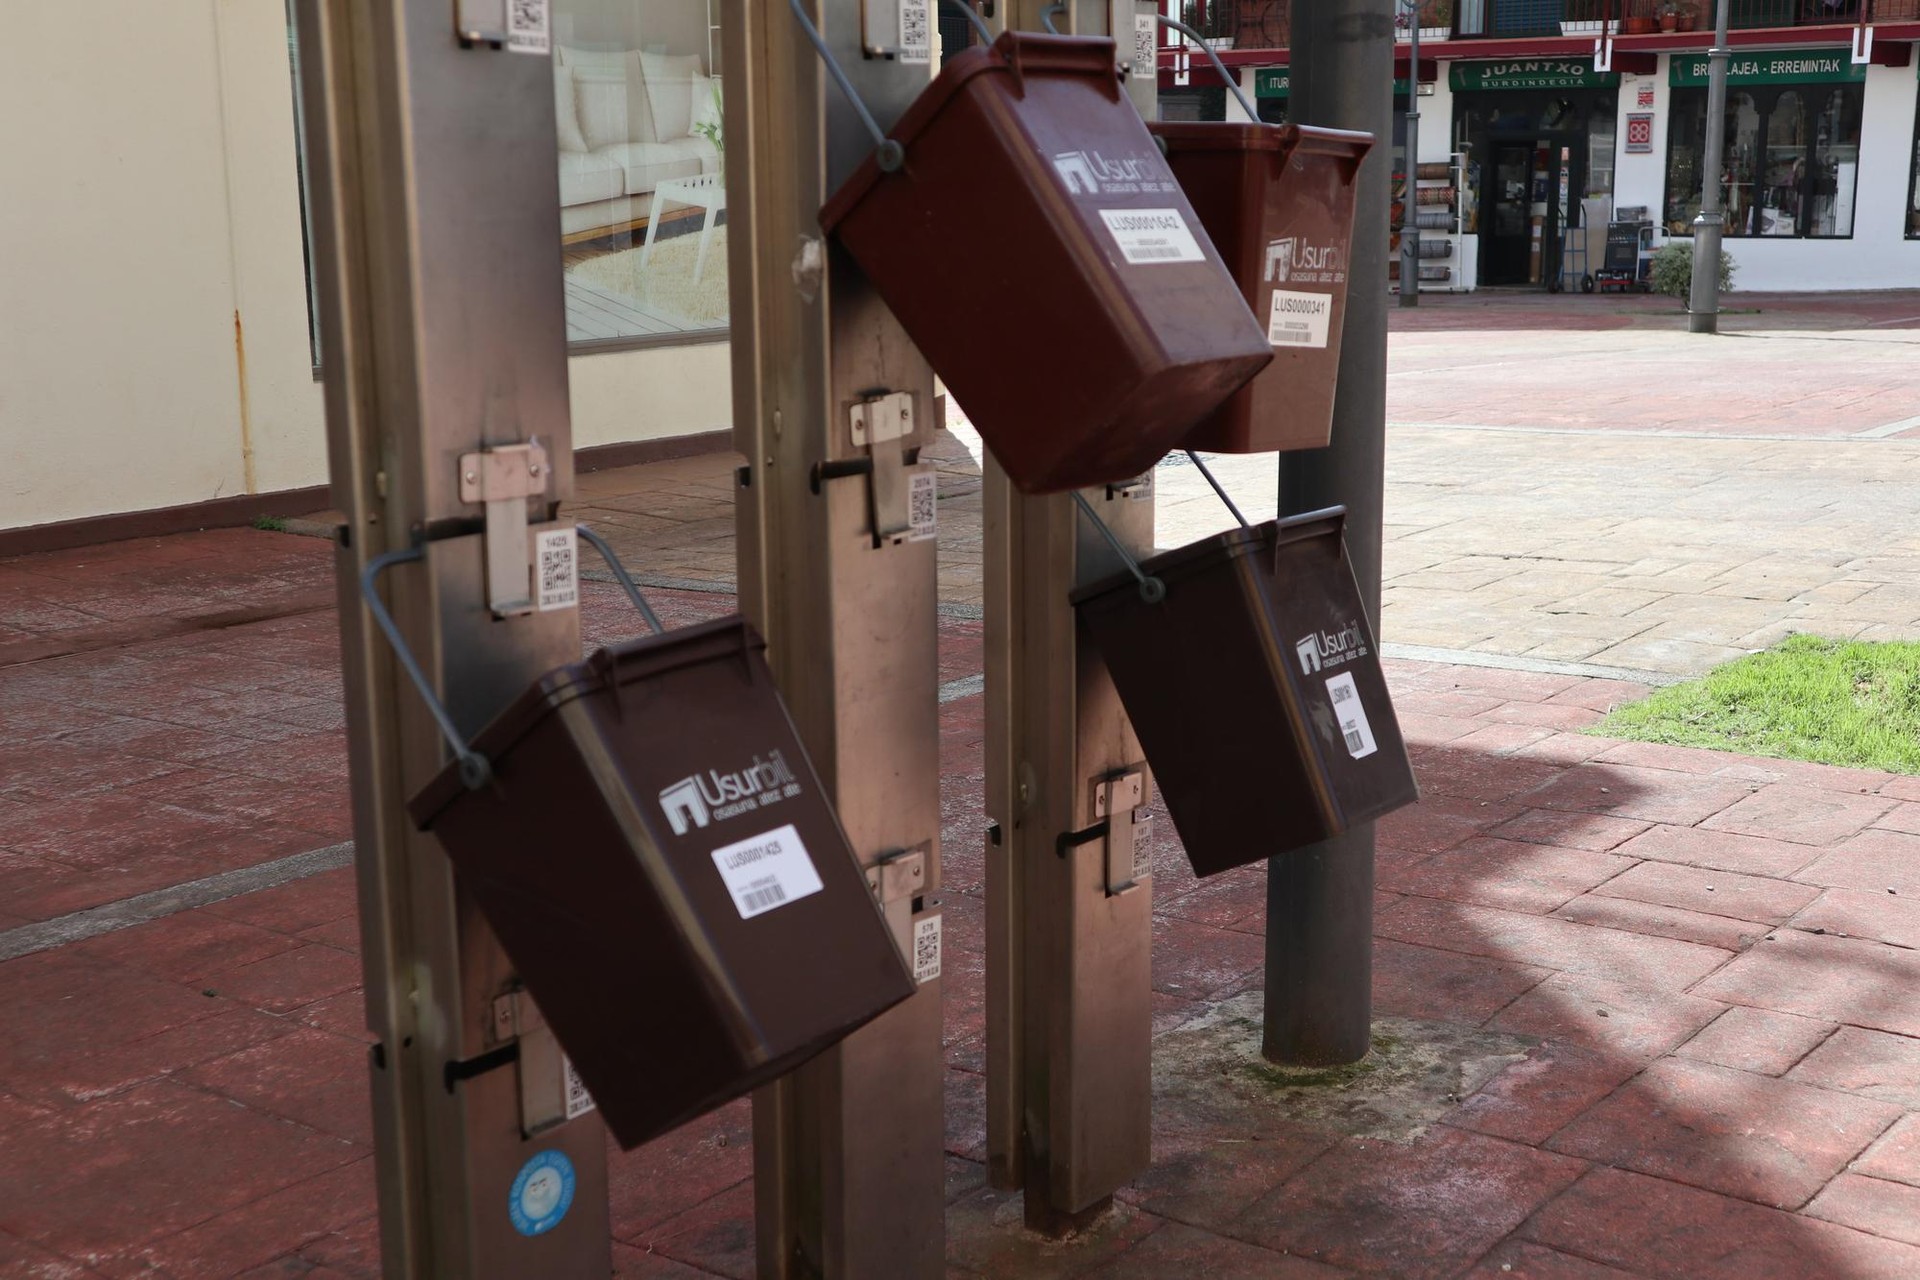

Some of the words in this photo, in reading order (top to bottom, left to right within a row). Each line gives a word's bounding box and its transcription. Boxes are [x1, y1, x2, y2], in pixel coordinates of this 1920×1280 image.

[1481, 62, 1584, 79] JUANTXO
[1770, 58, 1841, 75] ERREMINTAK
[1269, 77, 1290, 89] ITUR
[1481, 78, 1584, 88] BURDINDEGIA
[1292, 237, 1346, 270] Usurbil
[1274, 297, 1326, 315] LUS0000341
[1313, 618, 1365, 657] Usurbil
[694, 748, 796, 807] Usurbil
